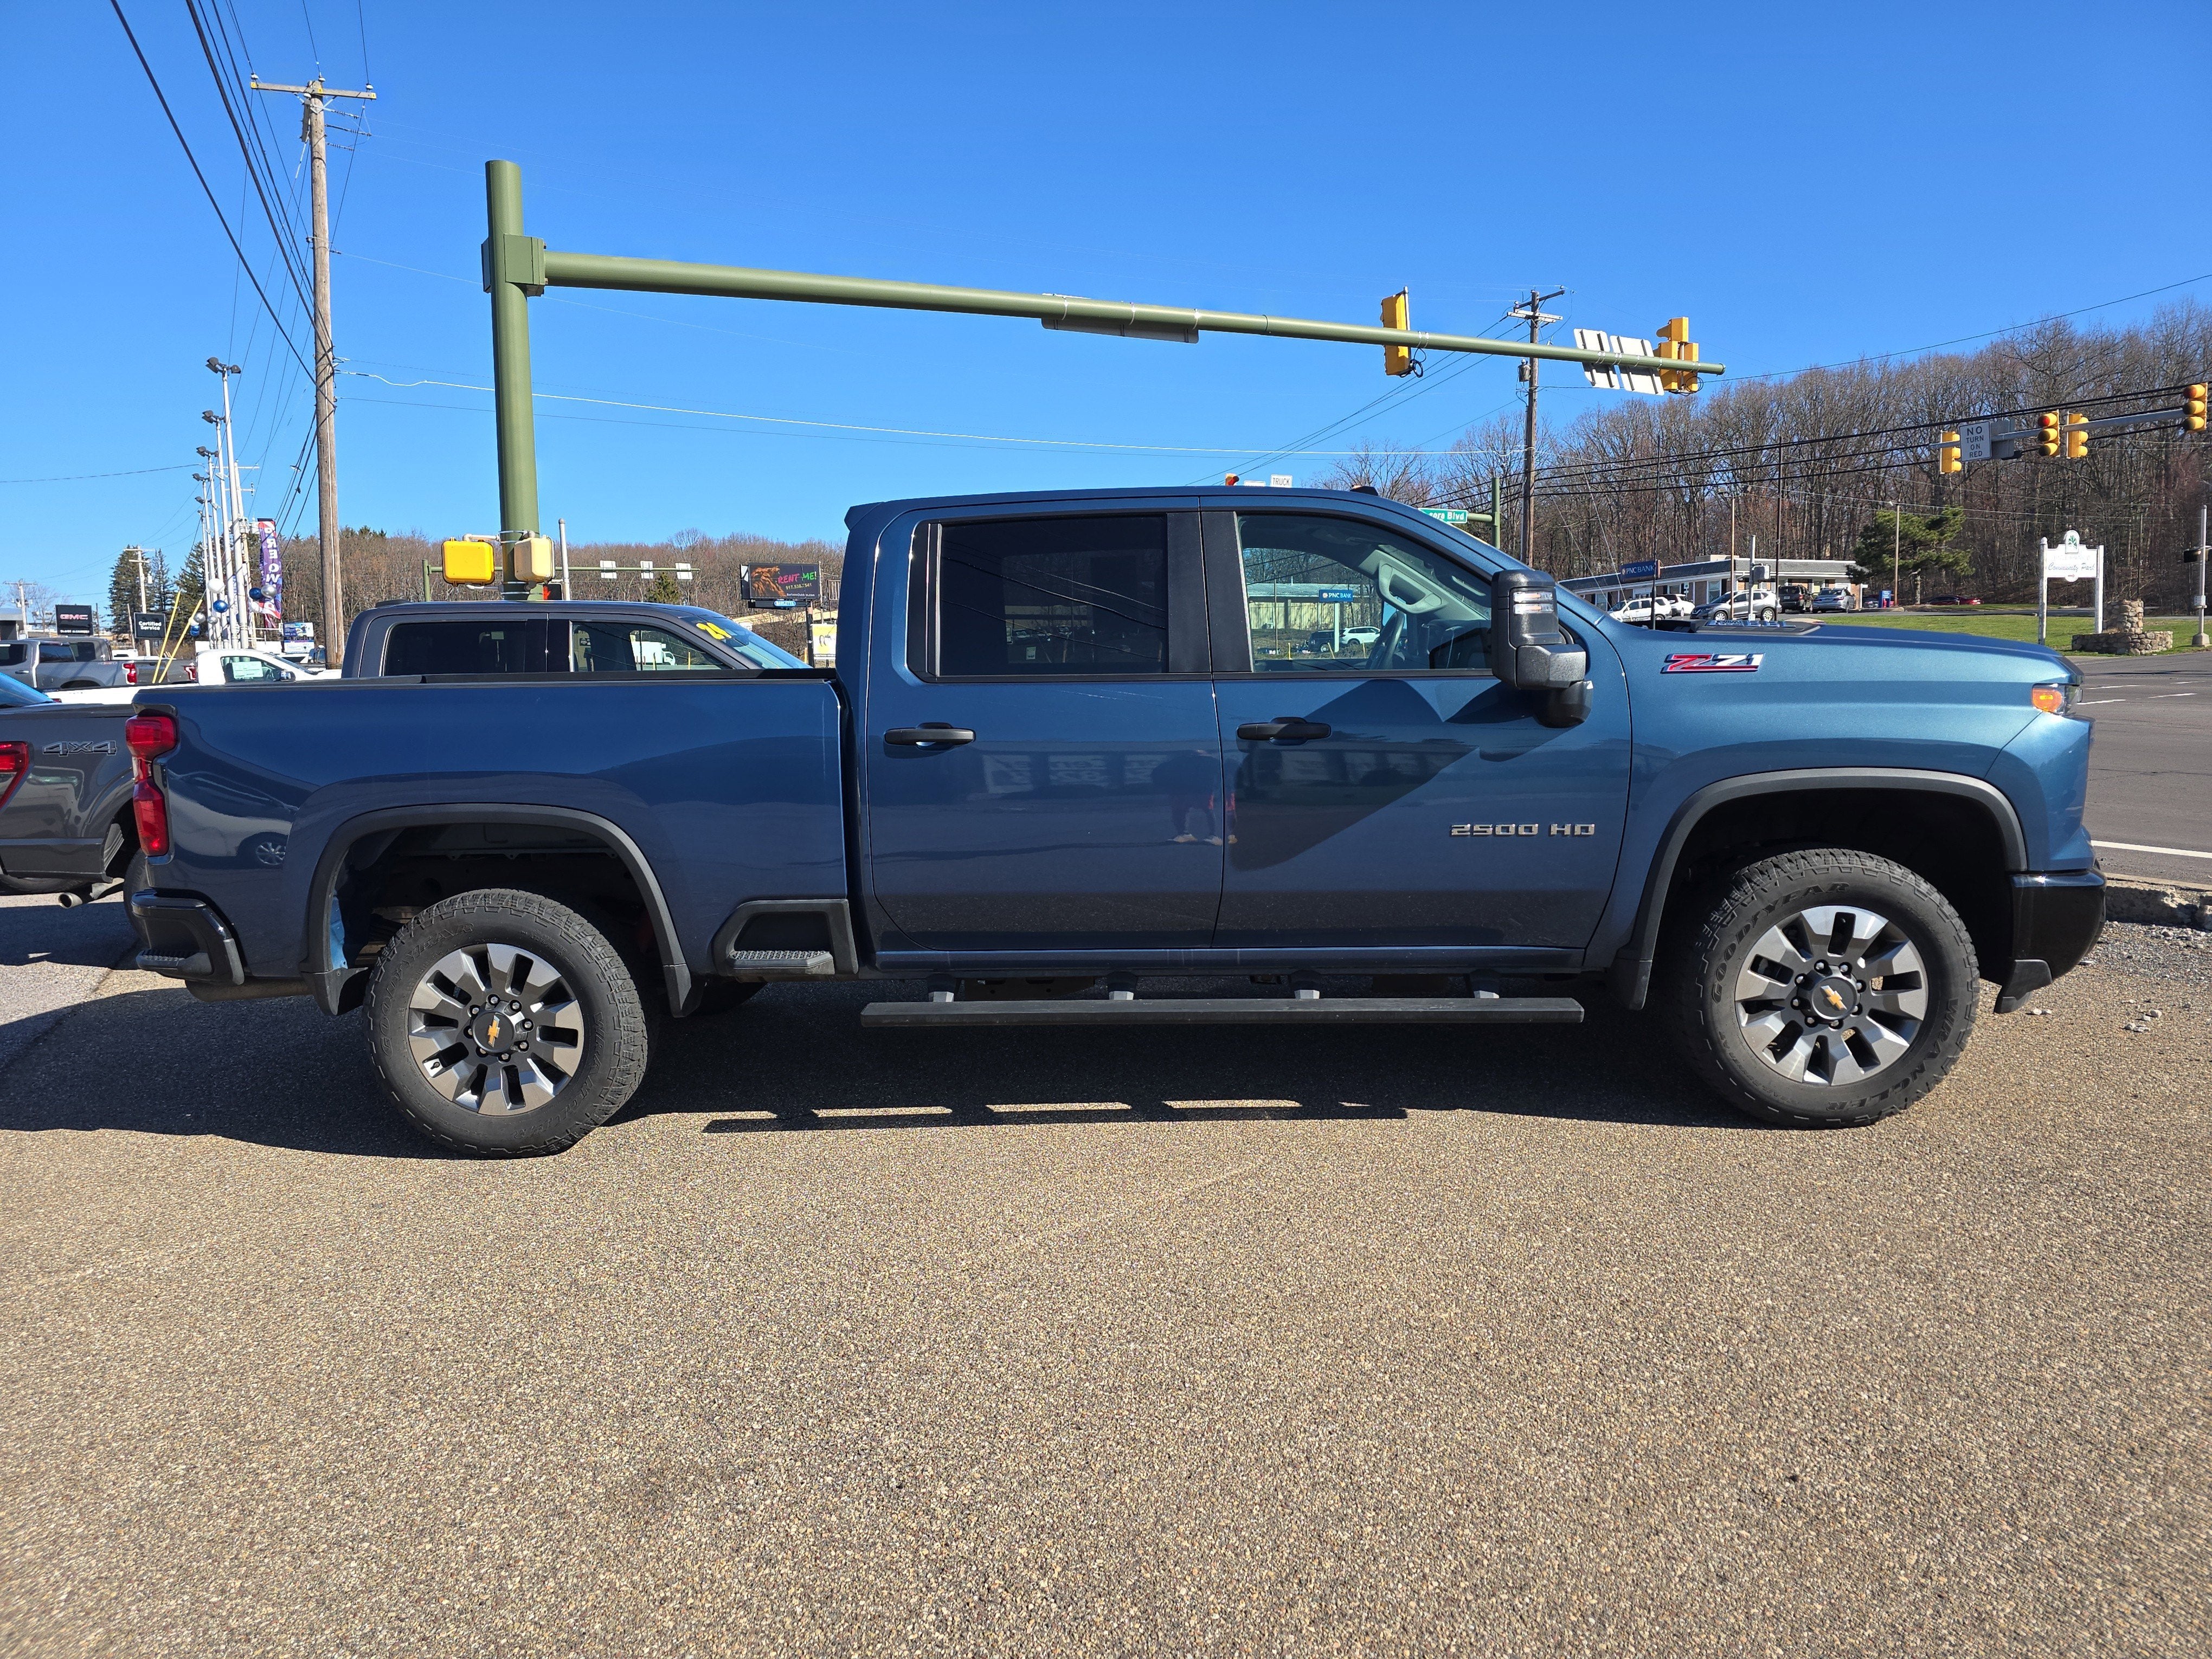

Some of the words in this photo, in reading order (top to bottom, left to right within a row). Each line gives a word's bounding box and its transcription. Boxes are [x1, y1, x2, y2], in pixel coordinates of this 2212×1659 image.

[1967, 426, 1982, 436] NO
[1966, 435, 1984, 443] TURN
[1272, 478, 1290, 486] TRUCK
[1447, 511, 1464, 520] Blvd
[2048, 562, 2078, 573] Community
[2081, 562, 2095, 570] Park
[778, 573, 800, 584] RENT
[801, 571, 817, 581] ME!
[1660, 653, 1766, 674] Z71
[1451, 824, 1539, 835] 2500
[1550, 824, 1595, 835] HD
[1712, 882, 1850, 1004] GOODYEAR
[381, 923, 474, 1057] GOODYEAR
[1825, 998, 1959, 1111] WRANGLER
